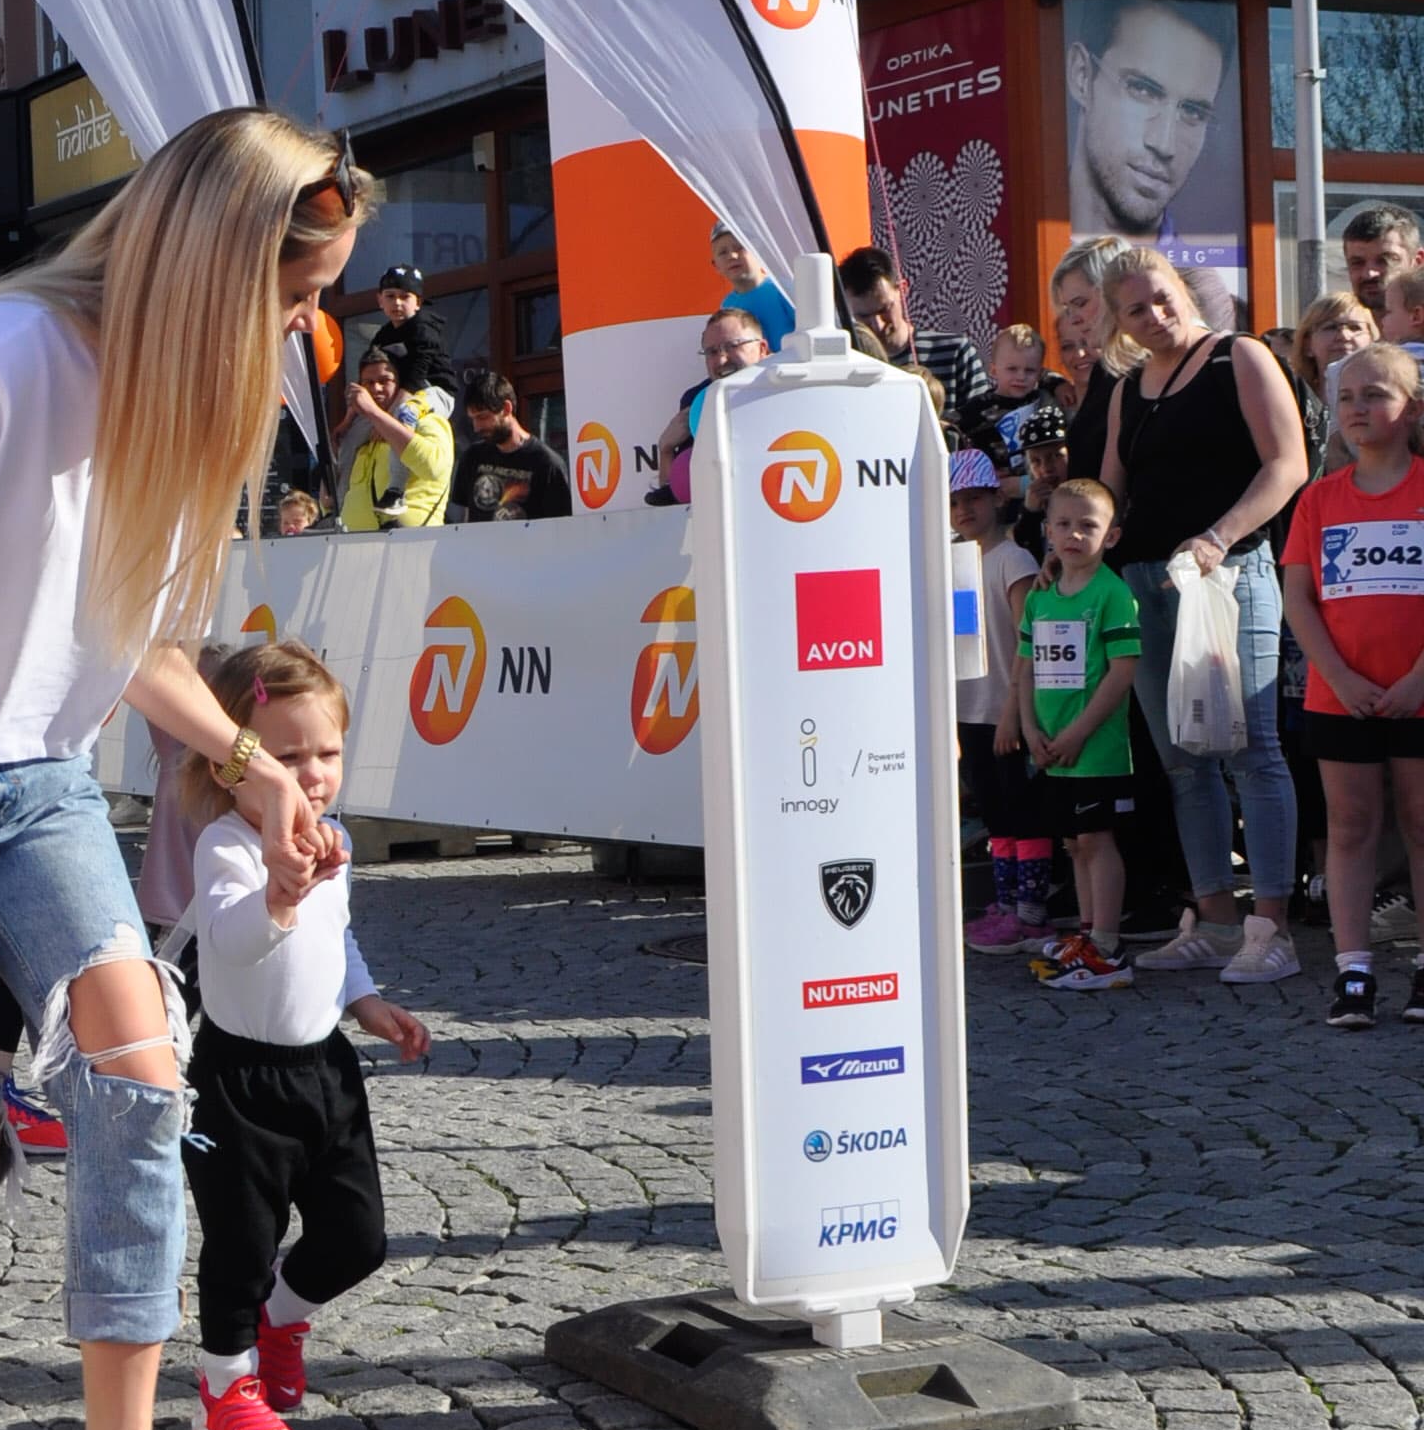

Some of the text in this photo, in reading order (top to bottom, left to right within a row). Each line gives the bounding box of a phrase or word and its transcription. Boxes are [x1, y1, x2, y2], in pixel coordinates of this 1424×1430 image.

[887, 42, 952, 71] OPTIKA
[870, 65, 1002, 123] UNETTES
[634, 445, 659, 473] N
[857, 458, 907, 488] NN
[1352, 546, 1423, 566] 3042
[806, 640, 874, 662] AVON
[498, 646, 552, 695] NN
[780, 796, 839, 814] innogy
[808, 978, 895, 1003] NUTREND
[835, 1127, 908, 1156] ŠKODA
[818, 1216, 897, 1248] KPMG
